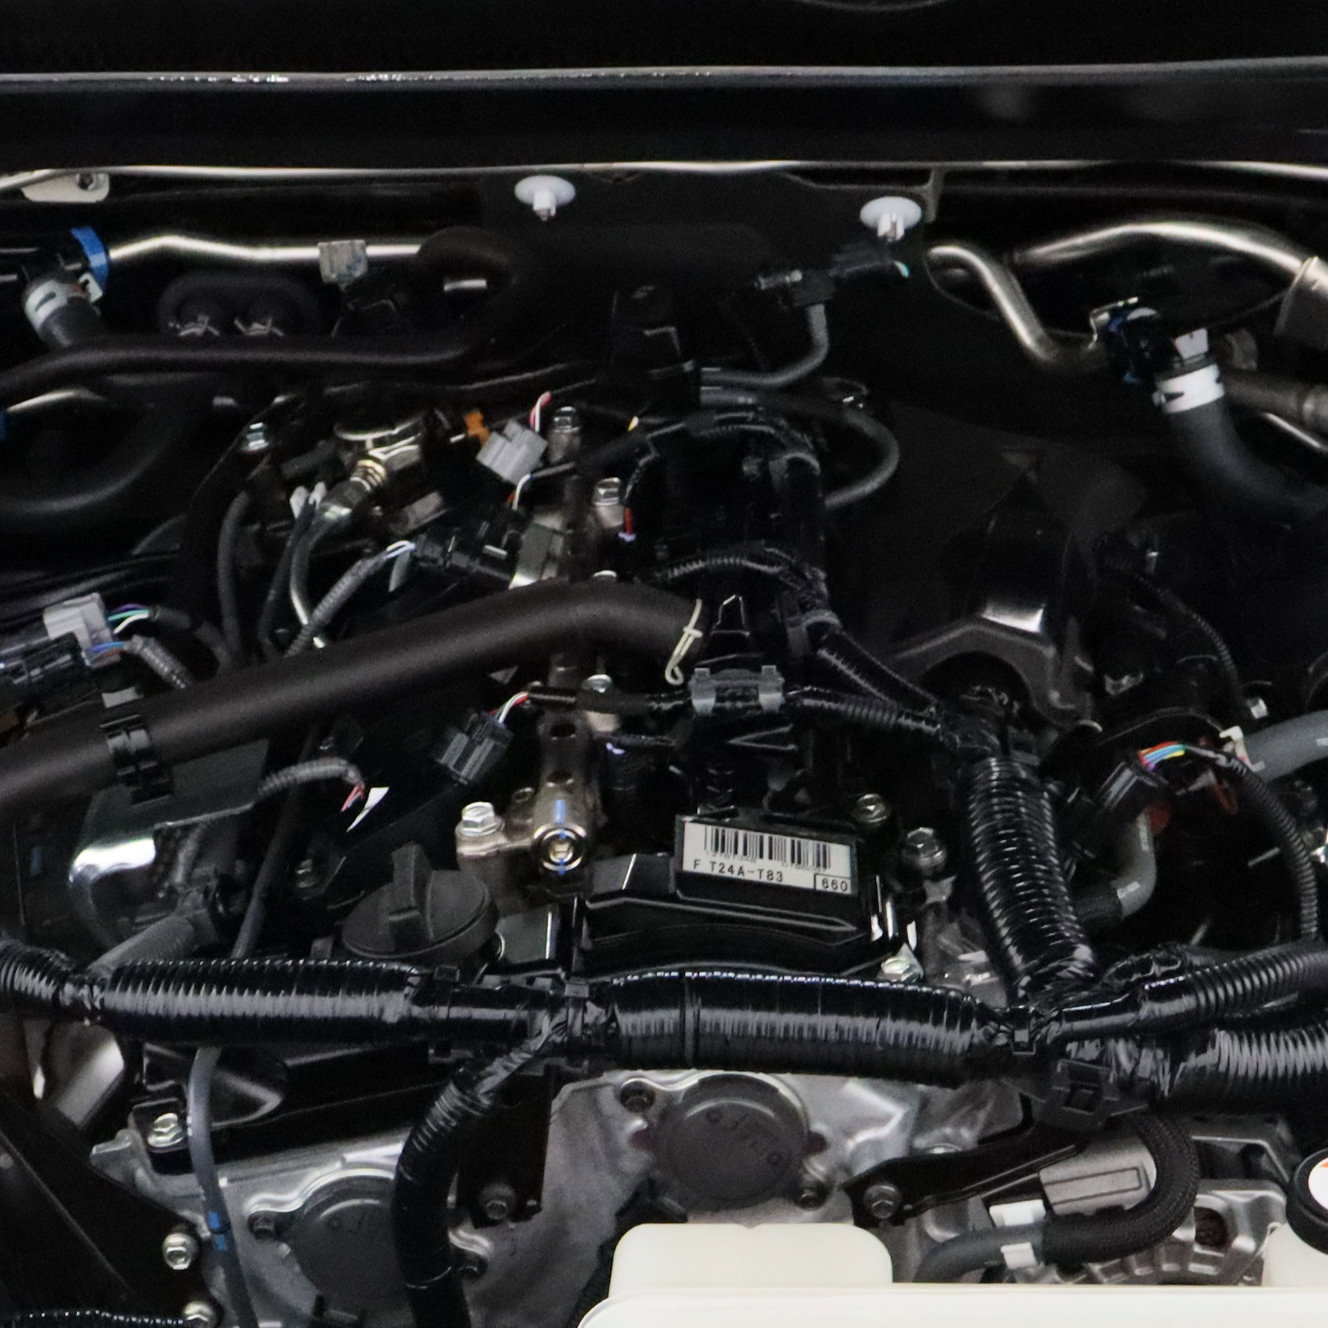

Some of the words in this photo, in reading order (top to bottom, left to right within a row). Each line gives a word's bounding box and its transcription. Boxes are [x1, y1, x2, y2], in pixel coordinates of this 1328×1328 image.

[693, 859, 702, 870] F
[709, 860, 784, 883] T24A-T83
[821, 877, 849, 892] 660
